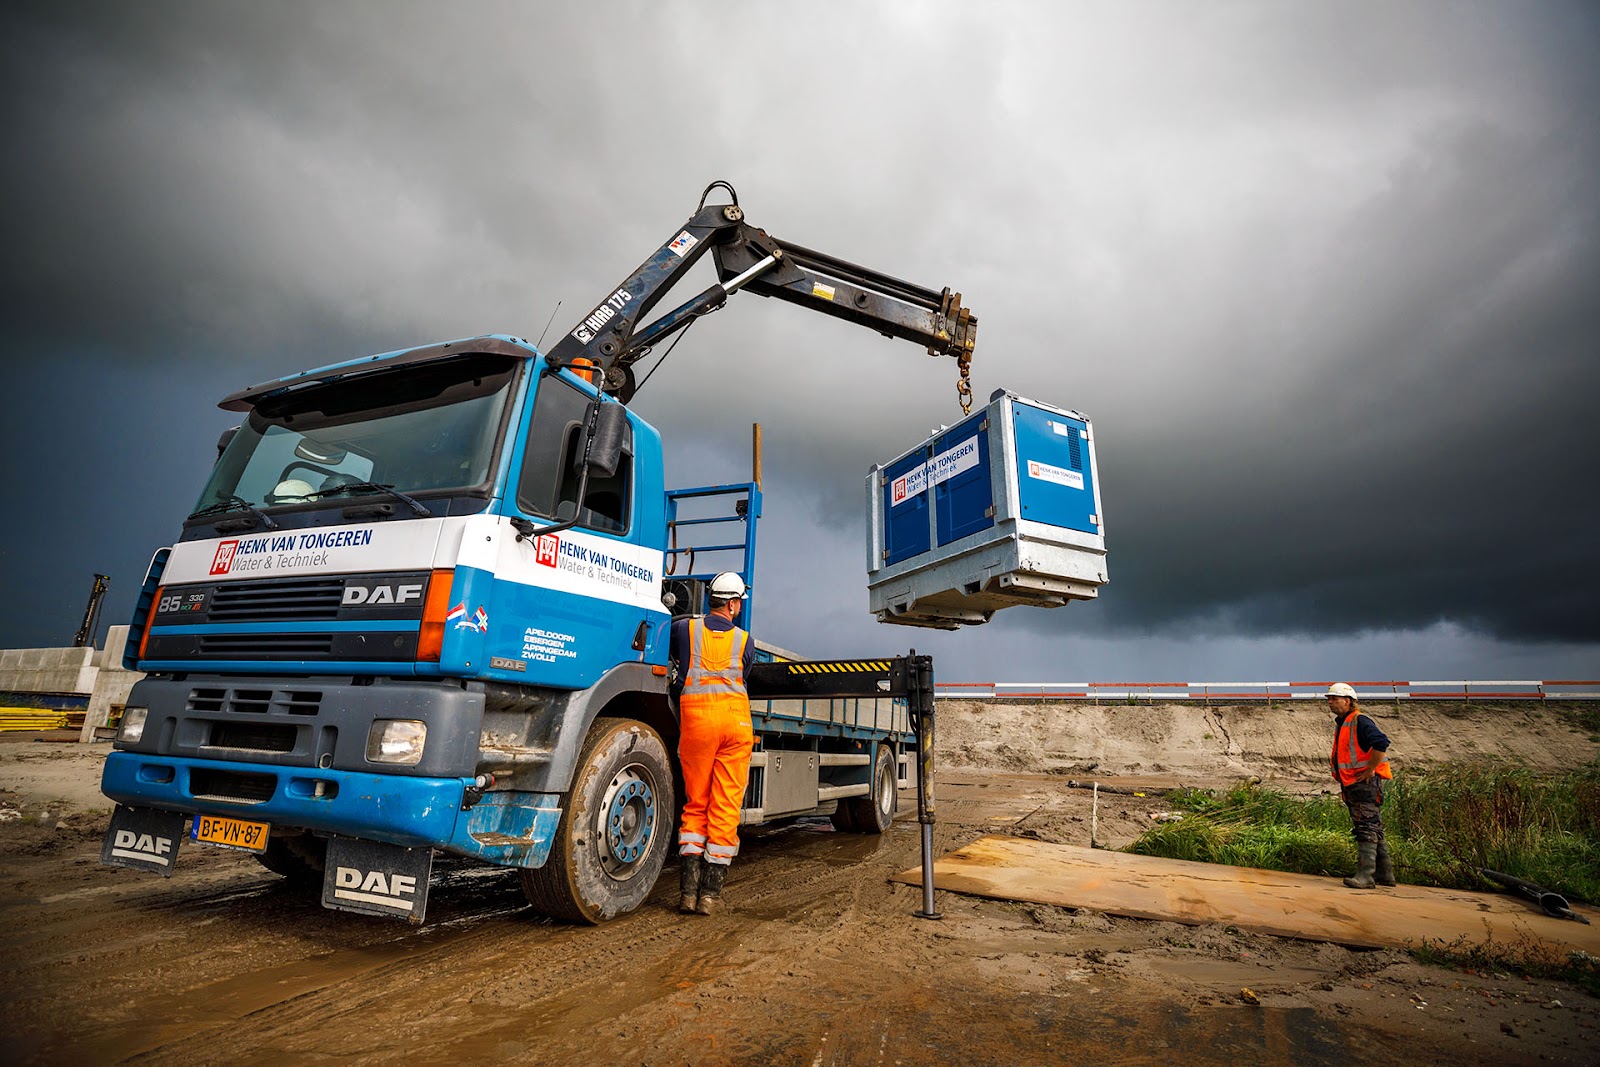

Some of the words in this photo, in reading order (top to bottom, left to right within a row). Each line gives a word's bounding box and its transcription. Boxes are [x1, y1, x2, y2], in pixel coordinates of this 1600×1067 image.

[585, 304, 615, 331] HIAB
[607, 288, 632, 310] 175
[938, 443, 974, 467] TONGEREN
[236, 538, 269, 555] HENK
[271, 535, 296, 552] VAN
[299, 529, 373, 550] TONGEREN
[232, 556, 262, 572] Water
[264, 555, 273, 569] &
[276, 550, 329, 568] Techniek
[560, 540, 587, 562] HENK
[589, 550, 608, 568] VAN
[610, 557, 654, 583] TONGEREN
[559, 556, 586, 575] Water
[588, 565, 594, 578] &
[597, 568, 632, 590] Techniek
[158, 595, 183, 613] 85
[189, 594, 205, 602] 330
[341, 584, 423, 605] DAF
[523, 635, 565, 649] EIBERGEN
[525, 627, 575, 643] APELDOORN
[521, 651, 556, 663] ZWOLLE
[522, 643, 577, 659] APPINGEDAM
[493, 658, 525, 670] DAF
[114, 829, 172, 855] DAF
[202, 820, 262, 845] BF-VN-87
[336, 866, 417, 896] DAF
